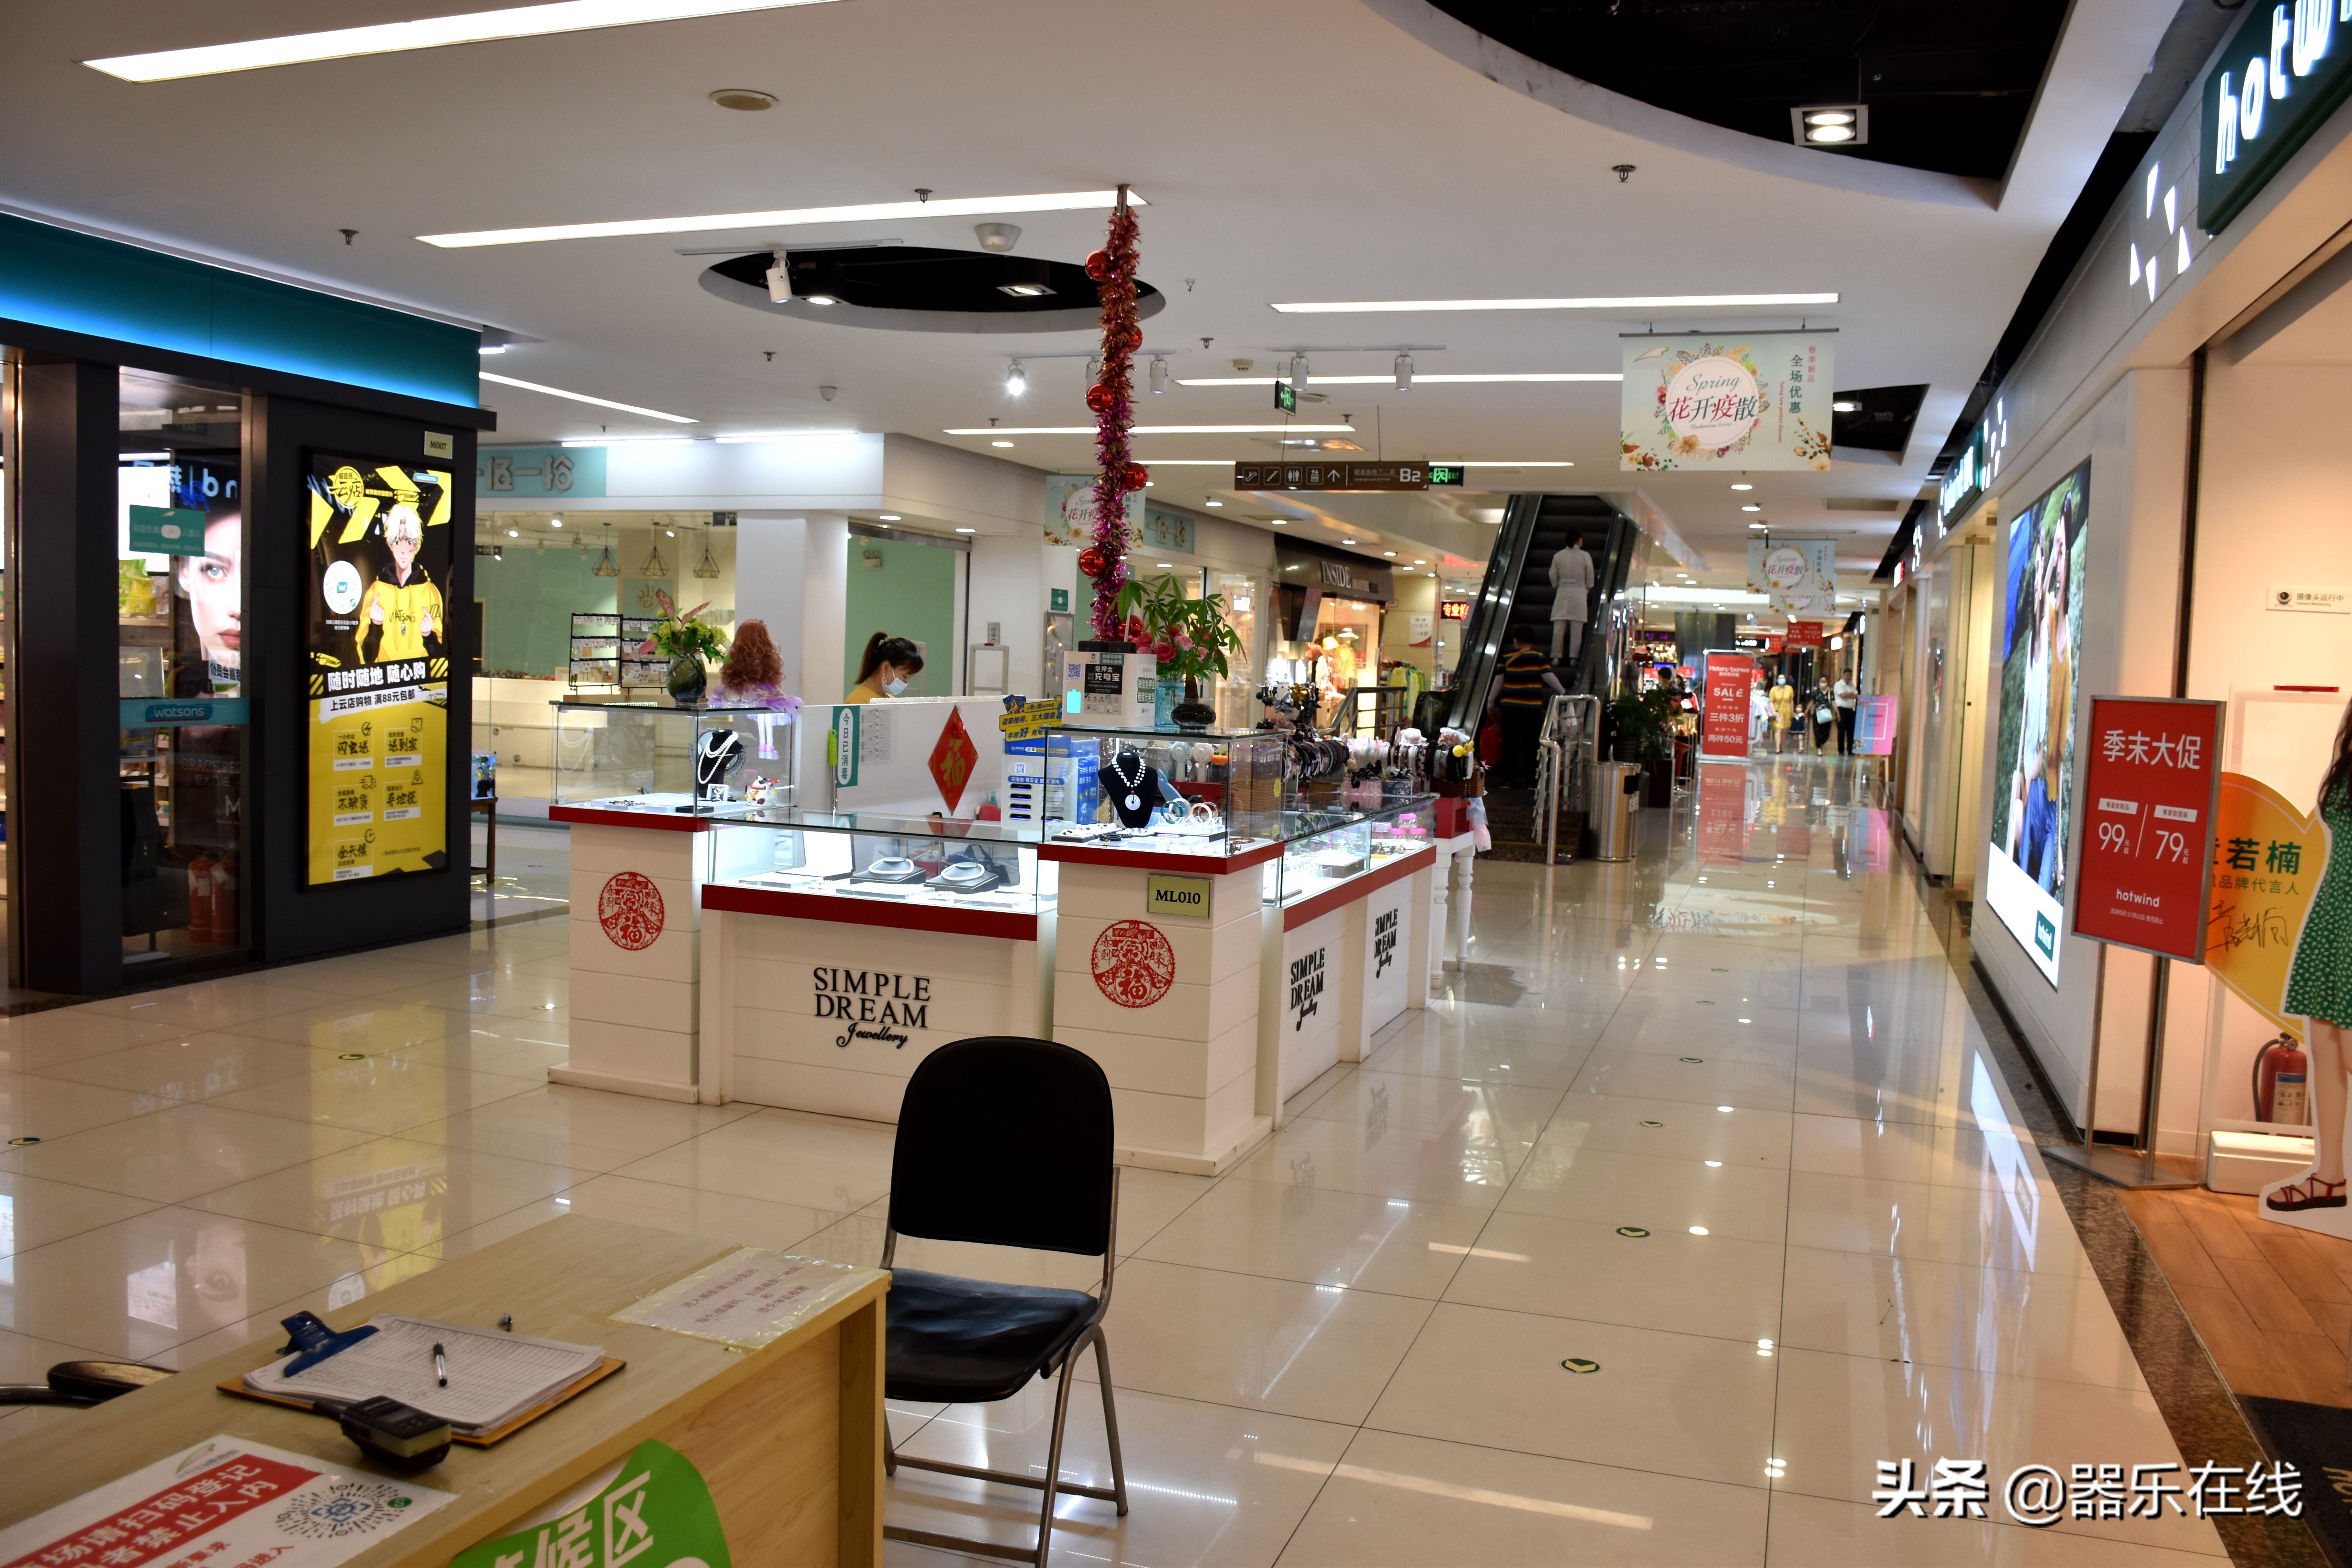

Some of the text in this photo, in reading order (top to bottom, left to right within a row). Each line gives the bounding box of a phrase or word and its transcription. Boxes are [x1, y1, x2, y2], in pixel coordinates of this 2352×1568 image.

[1808, 346, 1816, 383] 春季新品
[1686, 374, 1743, 395] Spring
[1789, 354, 1803, 414] 全场优惠
[1669, 394, 1758, 423] 花开疫散
[430, 441, 447, 450] M007
[1400, 468, 1421, 482] B2
[1321, 561, 1351, 588] INSIDE
[328, 661, 426, 692] 随时随地 随心购
[1094, 673, 1120, 682] 充电宝
[330, 689, 415, 711] 上云店购物 满88元包邮
[1713, 687, 1744, 698] SALE
[154, 707, 204, 718] watsons
[1709, 712, 1744, 723] 三件3折
[841, 712, 849, 780] 今日已消毒
[940, 733, 965, 787] 福
[2103, 730, 2201, 770] 季末大促
[2099, 822, 2125, 853] 99
[2156, 830, 2184, 862] 79
[1155, 889, 1201, 904] ML010
[2116, 888, 2160, 907] hotwind
[1374, 929, 1397, 959] DREAM
[1291, 947, 1325, 985] SIMPLE
[813, 967, 931, 1001] SIMPLE
[1290, 971, 1324, 1010] DREAM
[814, 994, 928, 1028] DREAM
[836, 1022, 908, 1049] Jewellery
[76, 1480, 279, 1568] 者禁止入内
